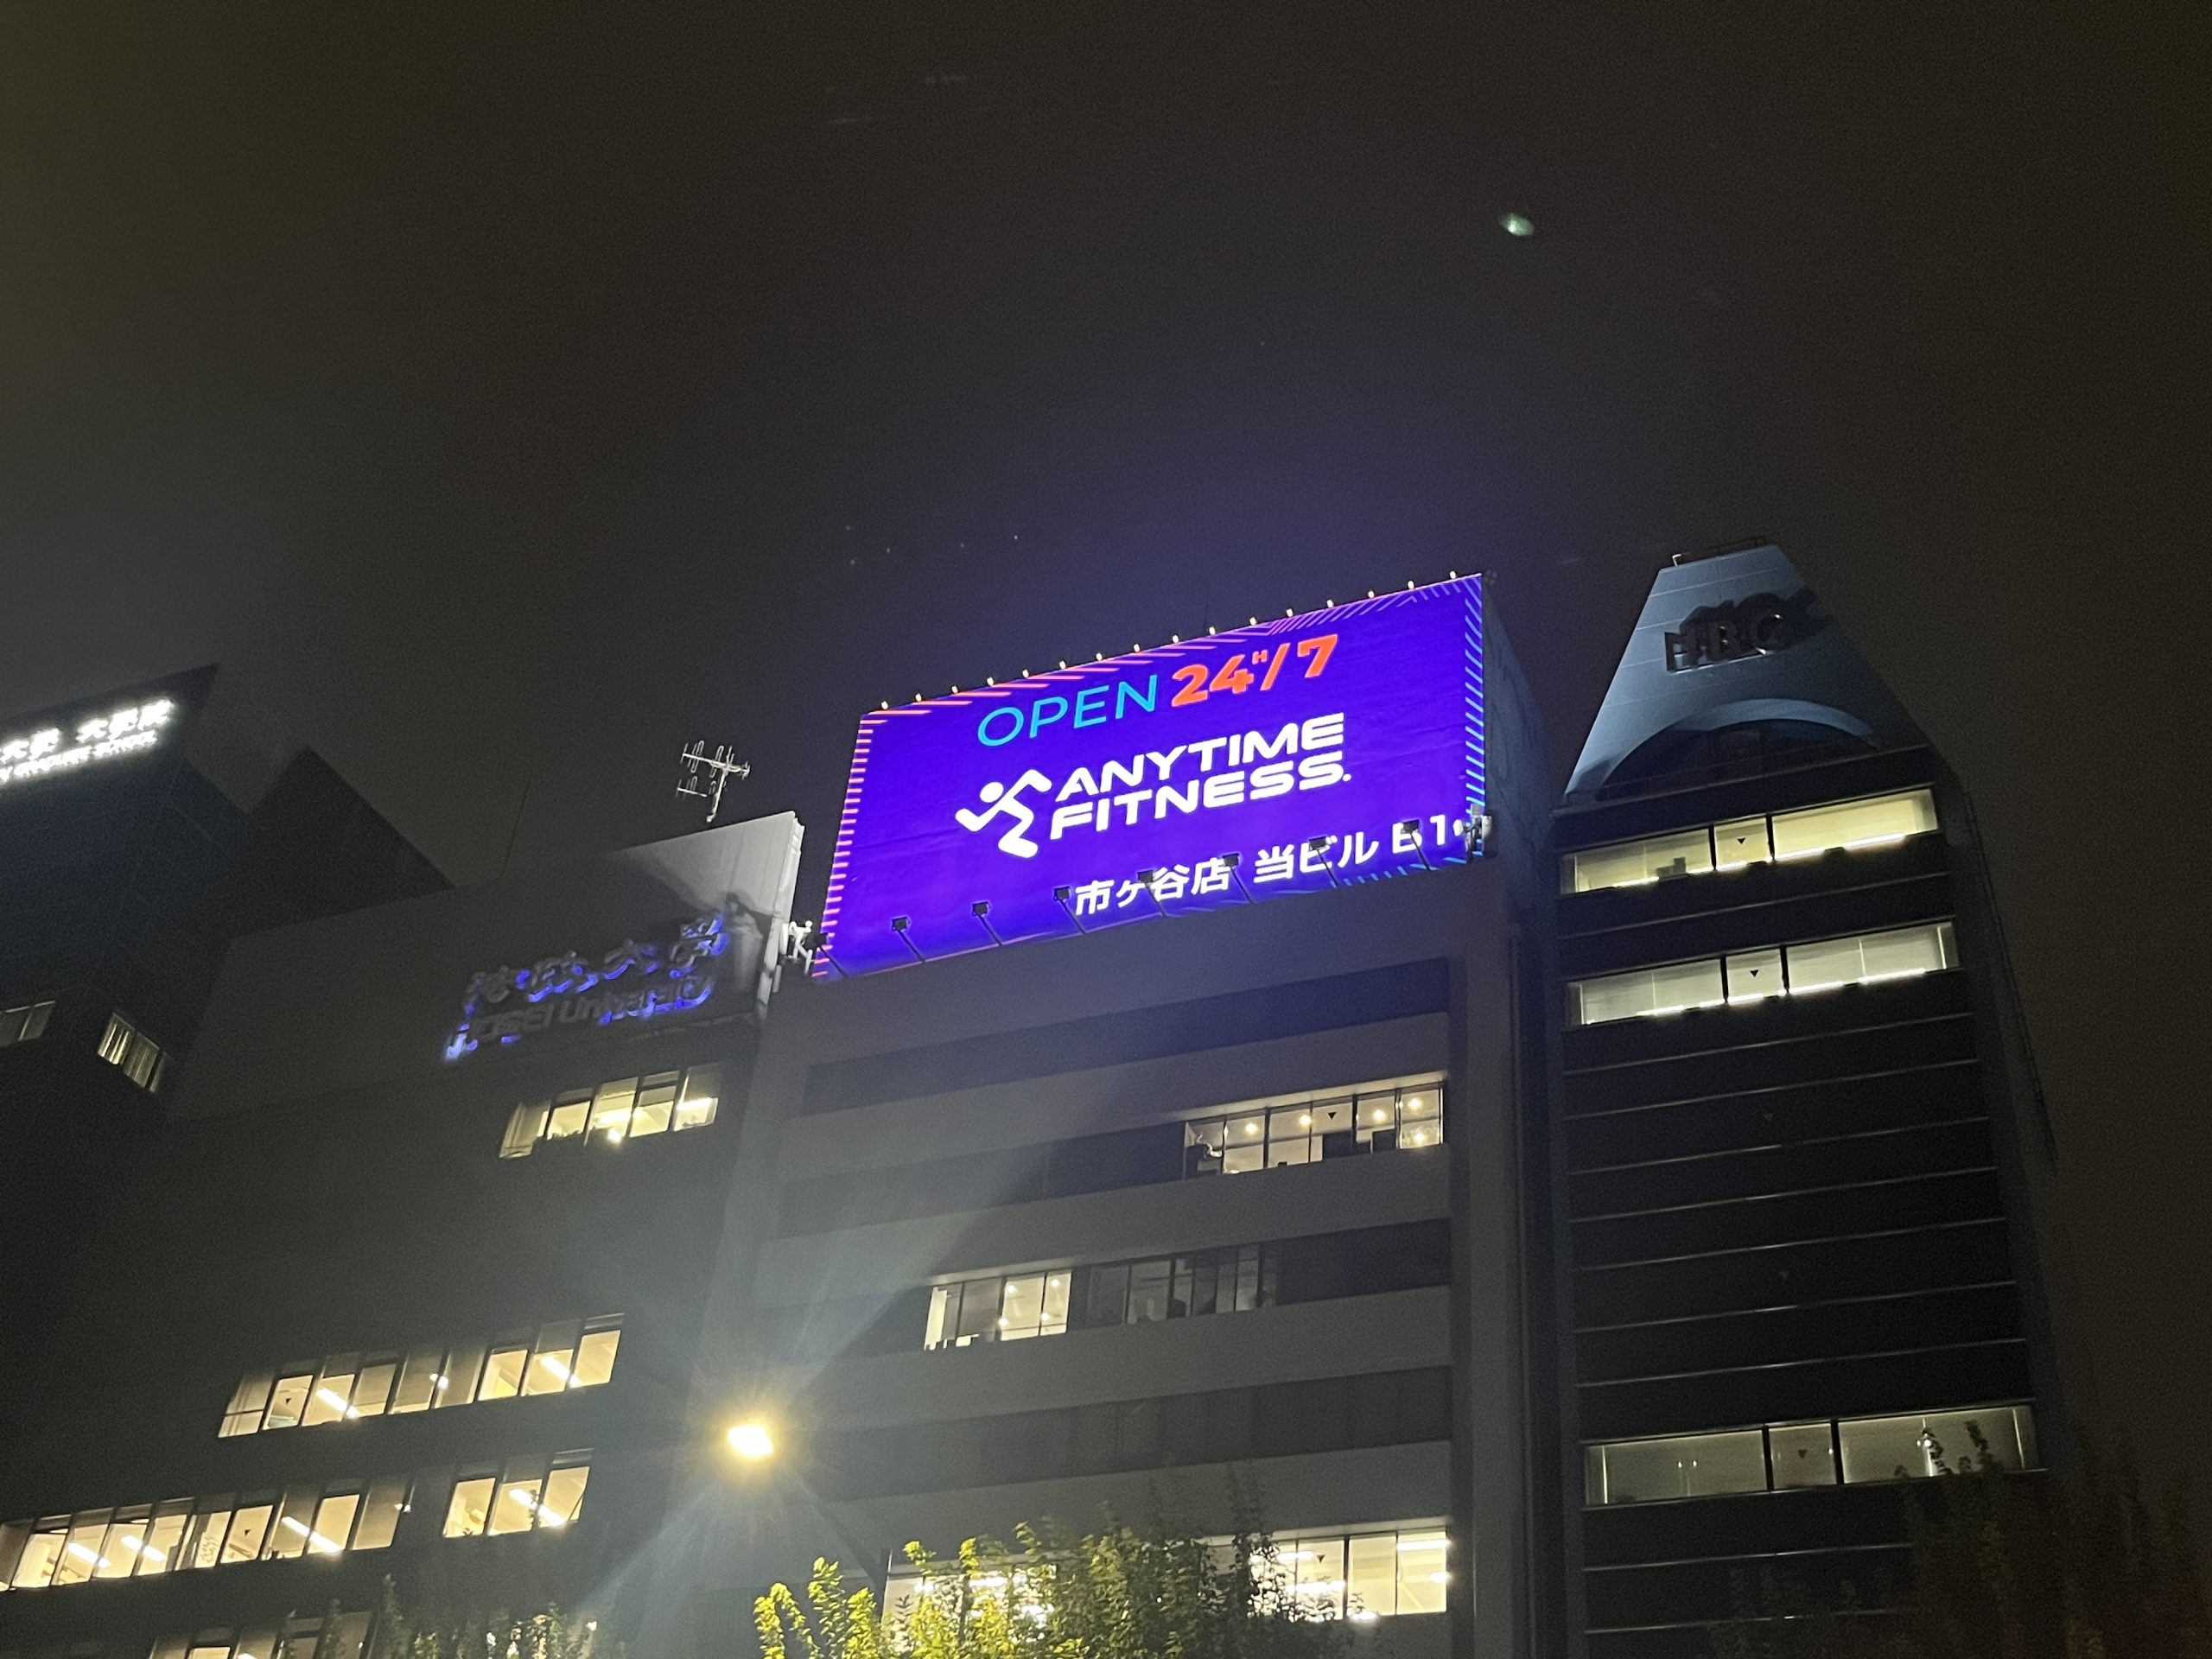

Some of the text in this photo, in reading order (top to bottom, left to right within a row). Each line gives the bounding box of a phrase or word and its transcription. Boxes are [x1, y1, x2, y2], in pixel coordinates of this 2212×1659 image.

[977, 673, 1158, 747] OPEN
[1055, 712, 1344, 804] ANYTIME
[1253, 831, 1380, 884] 当ビル
